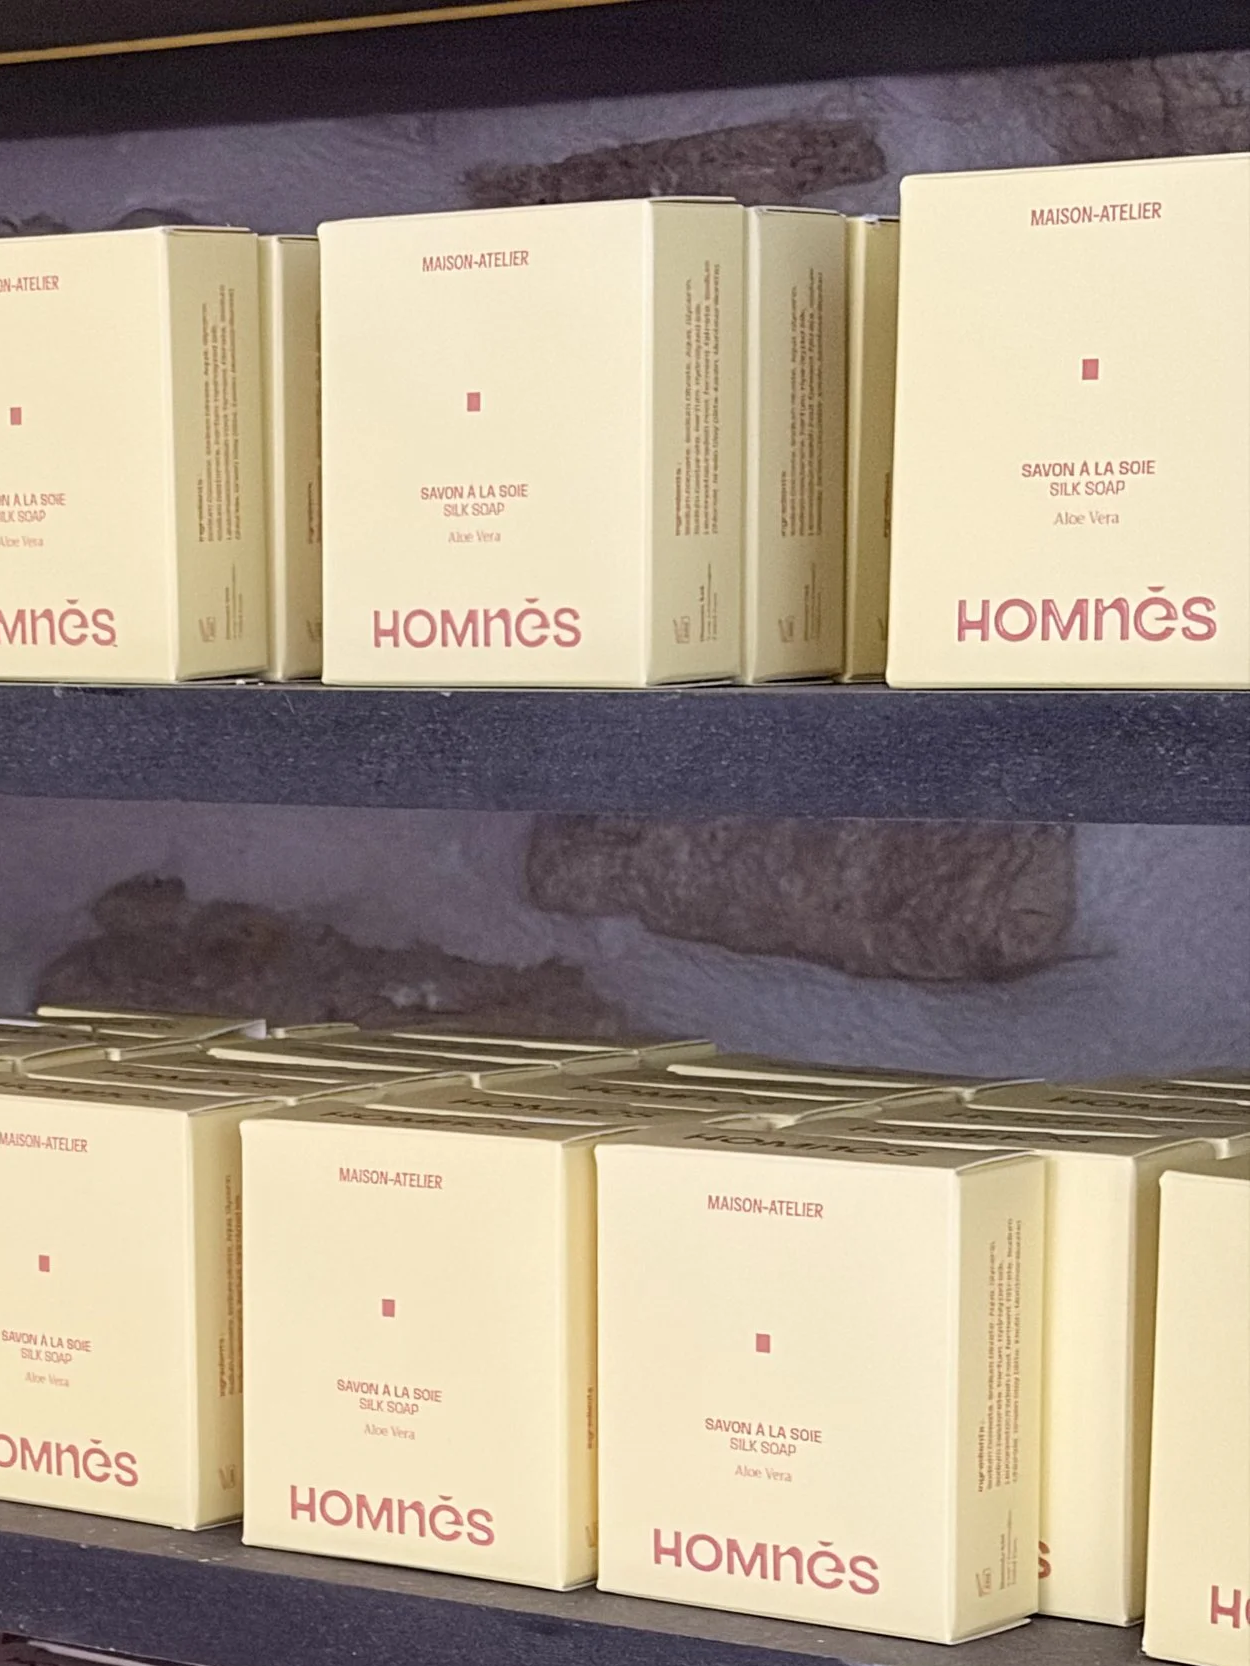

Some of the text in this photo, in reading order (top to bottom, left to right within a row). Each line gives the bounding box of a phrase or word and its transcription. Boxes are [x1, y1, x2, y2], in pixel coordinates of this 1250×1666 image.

[1030, 201, 1161, 226] MAISON-ATELIER
[422, 250, 529, 271] MAISON-ATELIER
[1021, 462, 1074, 477] SAVON
[1094, 461, 1114, 476] LA
[1118, 459, 1155, 475] SOIE
[420, 486, 463, 500] SAVON
[479, 484, 495, 498] LA
[499, 483, 527, 498] SOIE
[1049, 479, 1125, 496] SILK SOAP
[23, 493, 38, 506] LA
[40, 492, 65, 506] SOIE
[443, 501, 505, 517] SILK SOAP
[339, 1167, 442, 1189] MAISON-ATELIER
[707, 1194, 823, 1218] MAISON-ATELIER
[1, 1329, 37, 1345] SAVON
[49, 1336, 64, 1348] LA
[66, 1338, 90, 1352] SOIE
[20, 1347, 72, 1364] SILK SOAP
[336, 1378, 378, 1395] SAVON
[393, 1385, 409, 1398] LA
[413, 1387, 441, 1402] SOIE
[359, 1397, 419, 1415] SILK SOAP
[705, 1417, 751, 1435] SAVON
[768, 1424, 786, 1439] LA
[790, 1427, 821, 1443] SOIE
[729, 1437, 796, 1456] SILK SOAP
